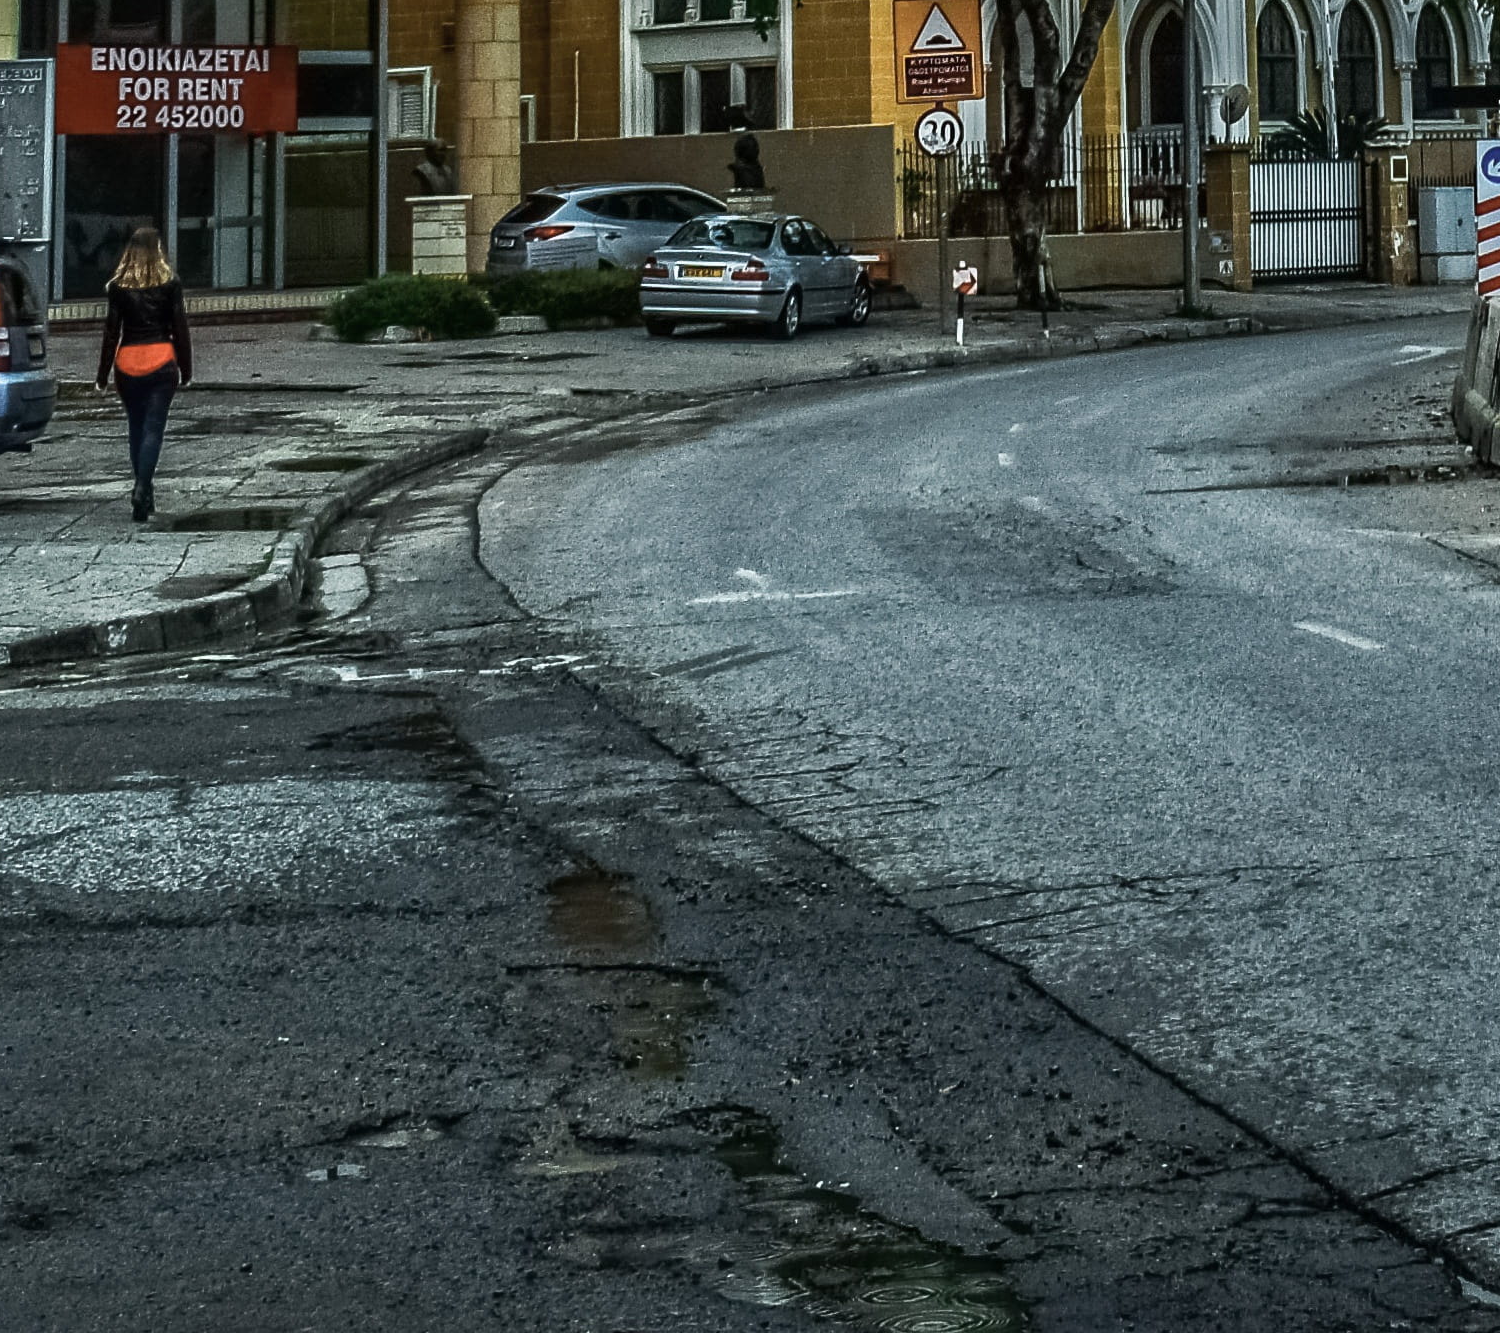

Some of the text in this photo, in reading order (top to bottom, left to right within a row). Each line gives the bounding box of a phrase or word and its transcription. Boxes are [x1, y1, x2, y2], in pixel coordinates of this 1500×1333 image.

[90, 47, 270, 73] ΕΝΟΙΚΙΑΖΕΤΑΙ
[118, 77, 244, 101] FOR RENT
[116, 104, 245, 129] 22 452000
